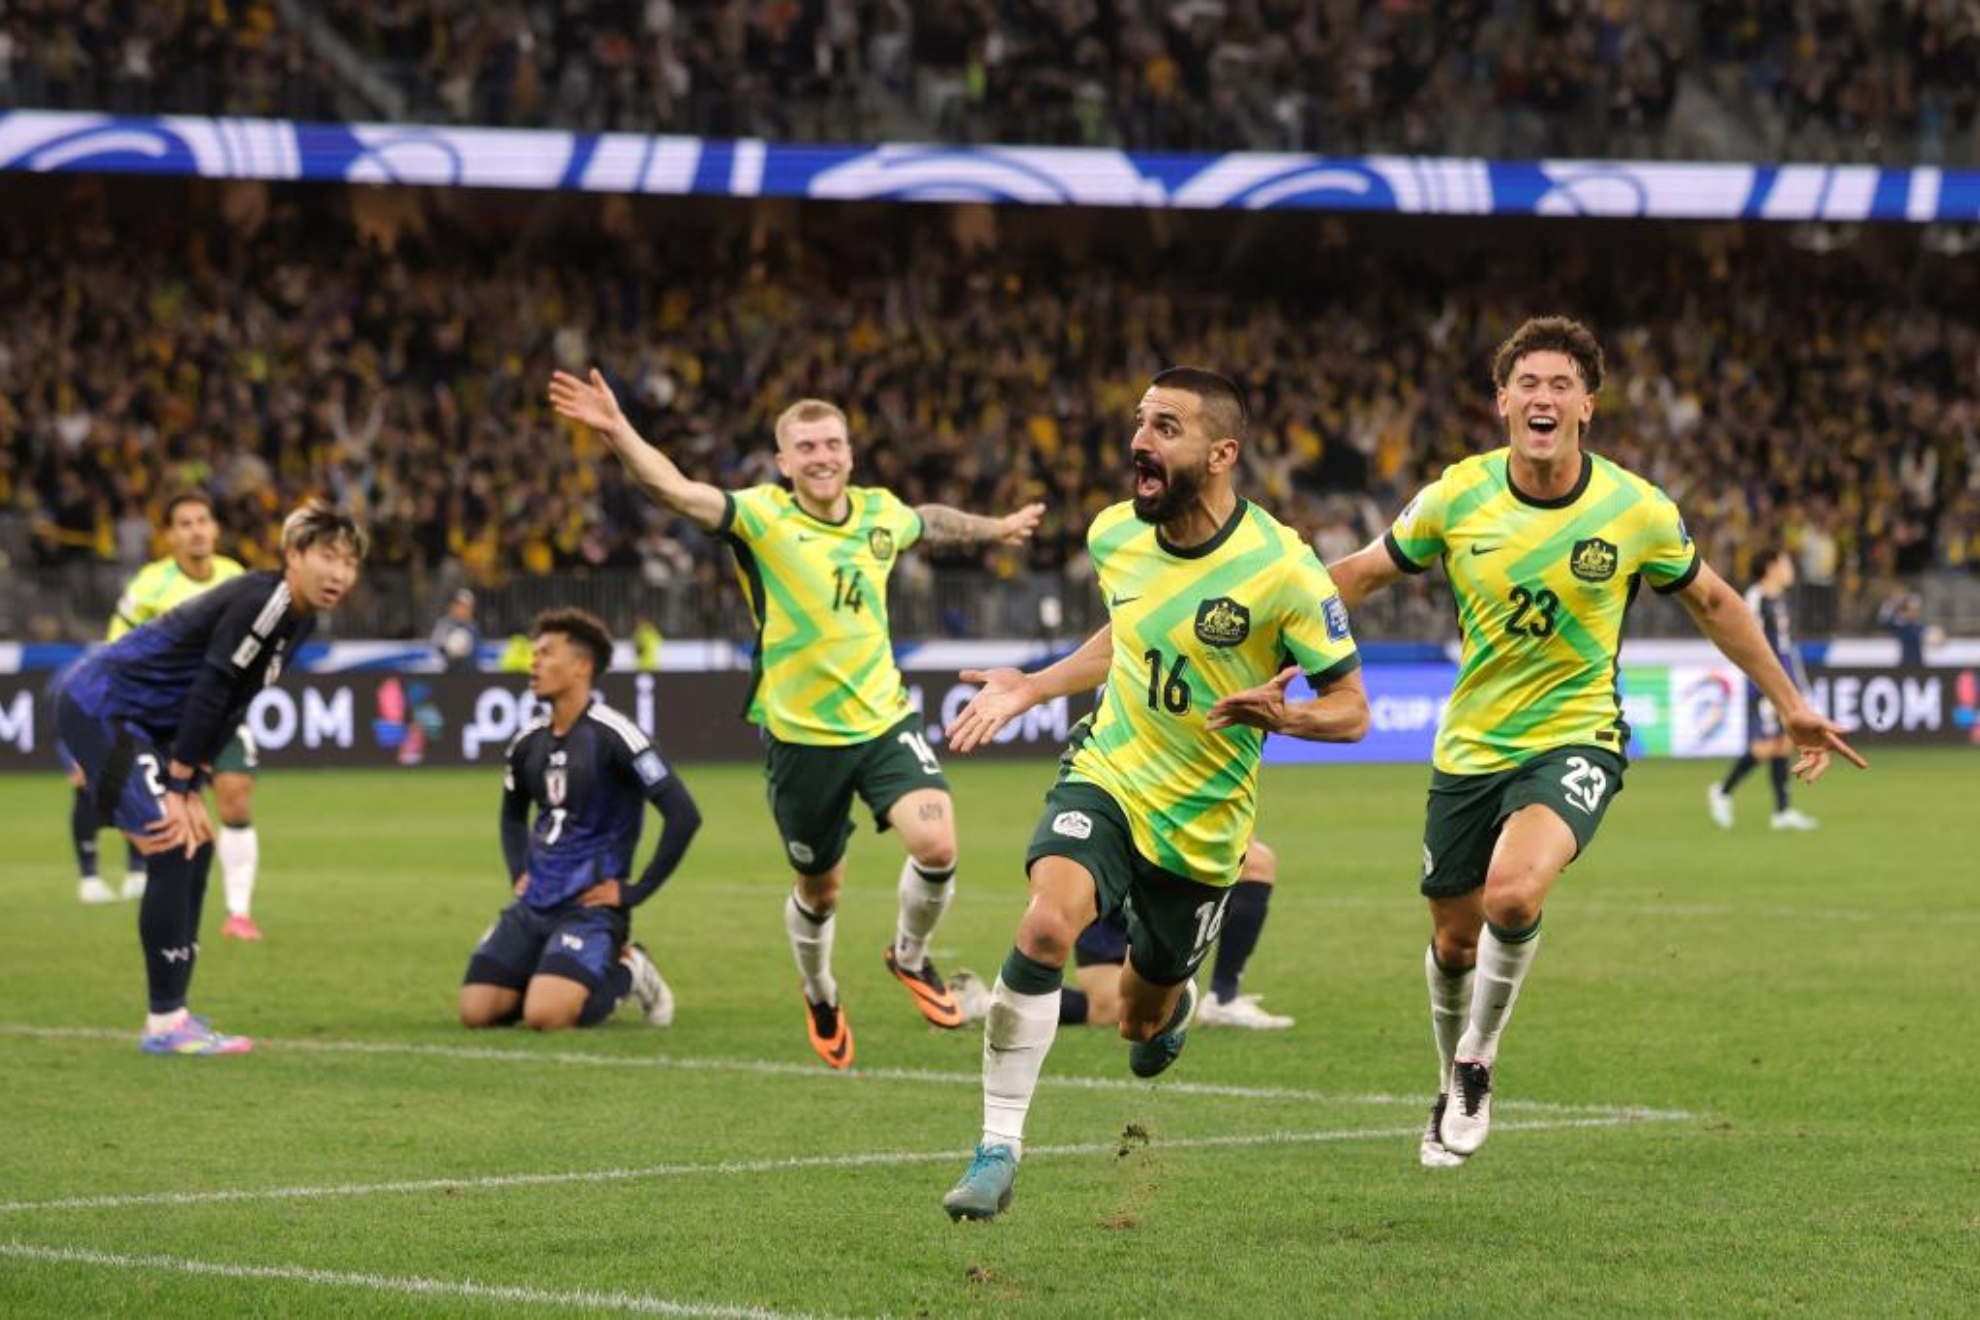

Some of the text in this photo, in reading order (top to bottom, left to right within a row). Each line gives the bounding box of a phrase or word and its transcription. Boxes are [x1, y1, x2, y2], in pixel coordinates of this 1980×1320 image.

[831, 567, 863, 614] 14
[1505, 586, 1560, 637] 23
[1144, 648, 1192, 717] 16
[1810, 676, 1941, 732] NEOM
[247, 685, 354, 750] OM
[1561, 756, 1606, 812] 23
[546, 809, 567, 845] 7
